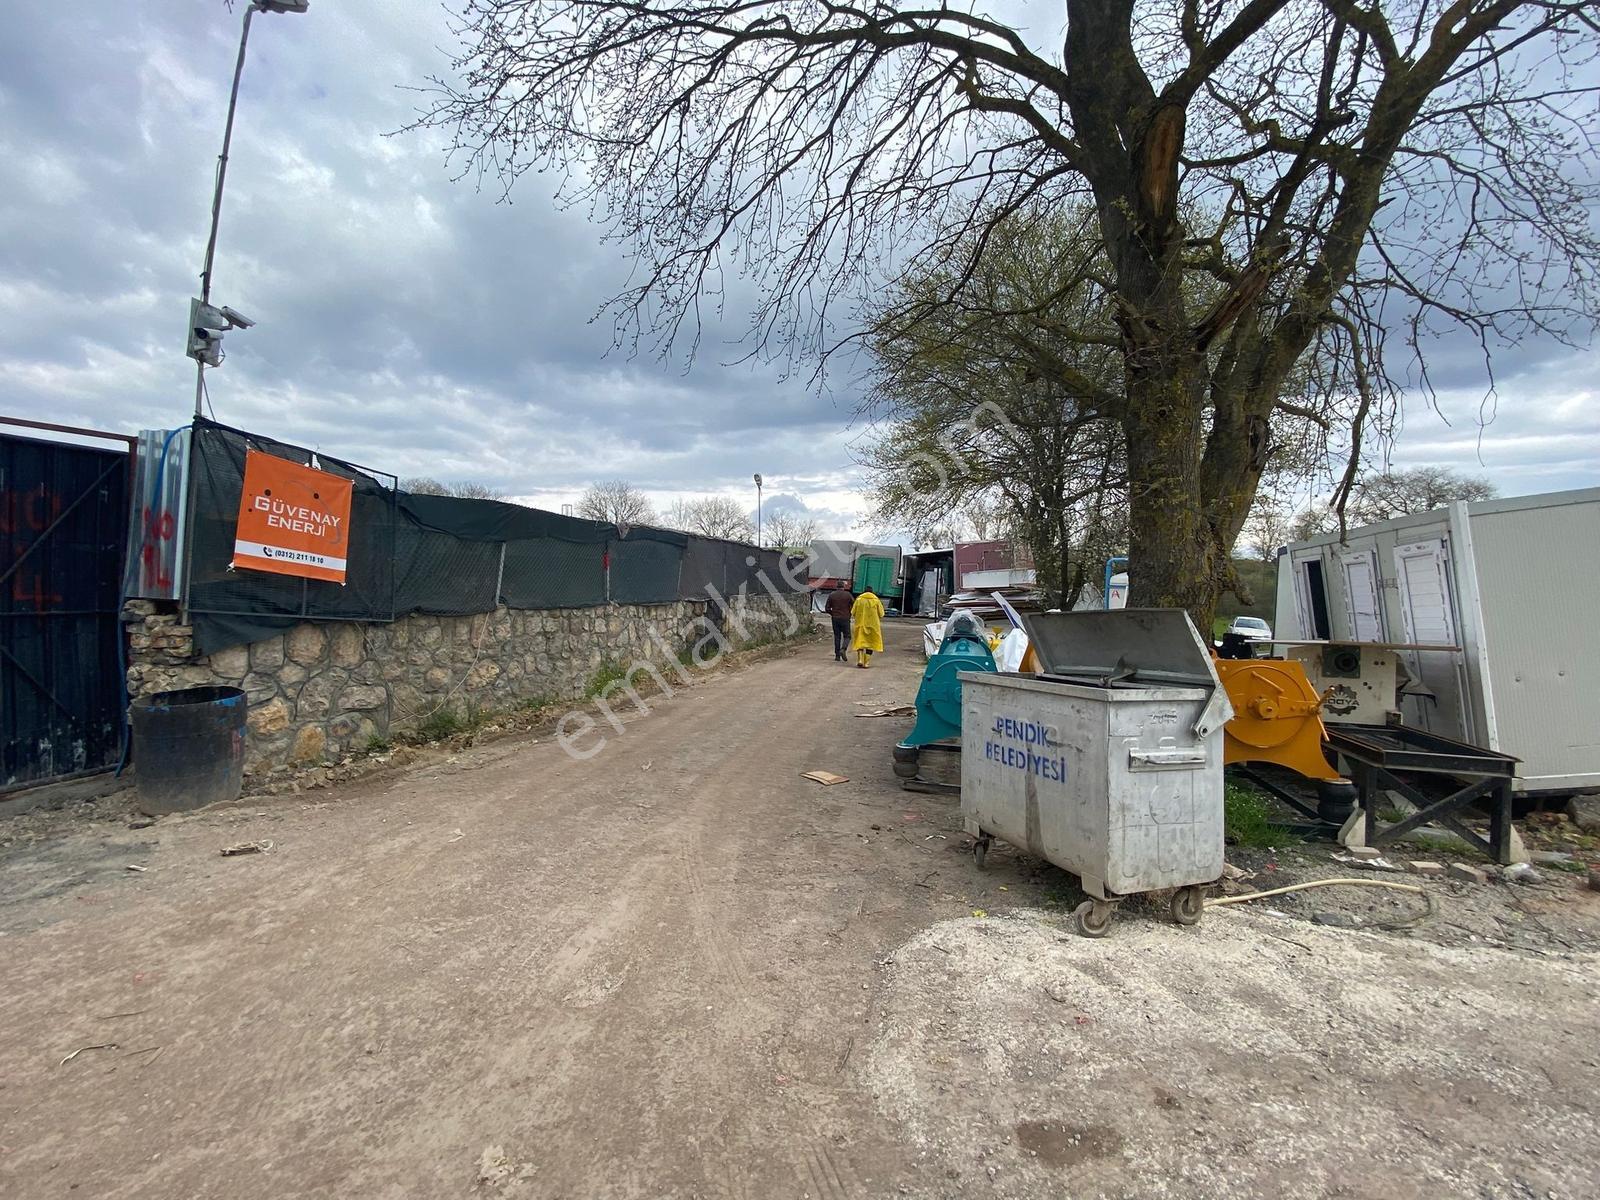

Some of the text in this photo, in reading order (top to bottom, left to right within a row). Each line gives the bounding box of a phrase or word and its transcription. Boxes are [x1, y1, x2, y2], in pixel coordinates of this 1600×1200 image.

[254, 495, 341, 527] GÜVENAY
[267, 514, 326, 537] ENERJİ
[274, 550, 295, 560] (0312)
[296, 553, 308, 561] 211
[994, 716, 1050, 748] PENDİK
[985, 740, 1066, 784] BELEDİYESİ
